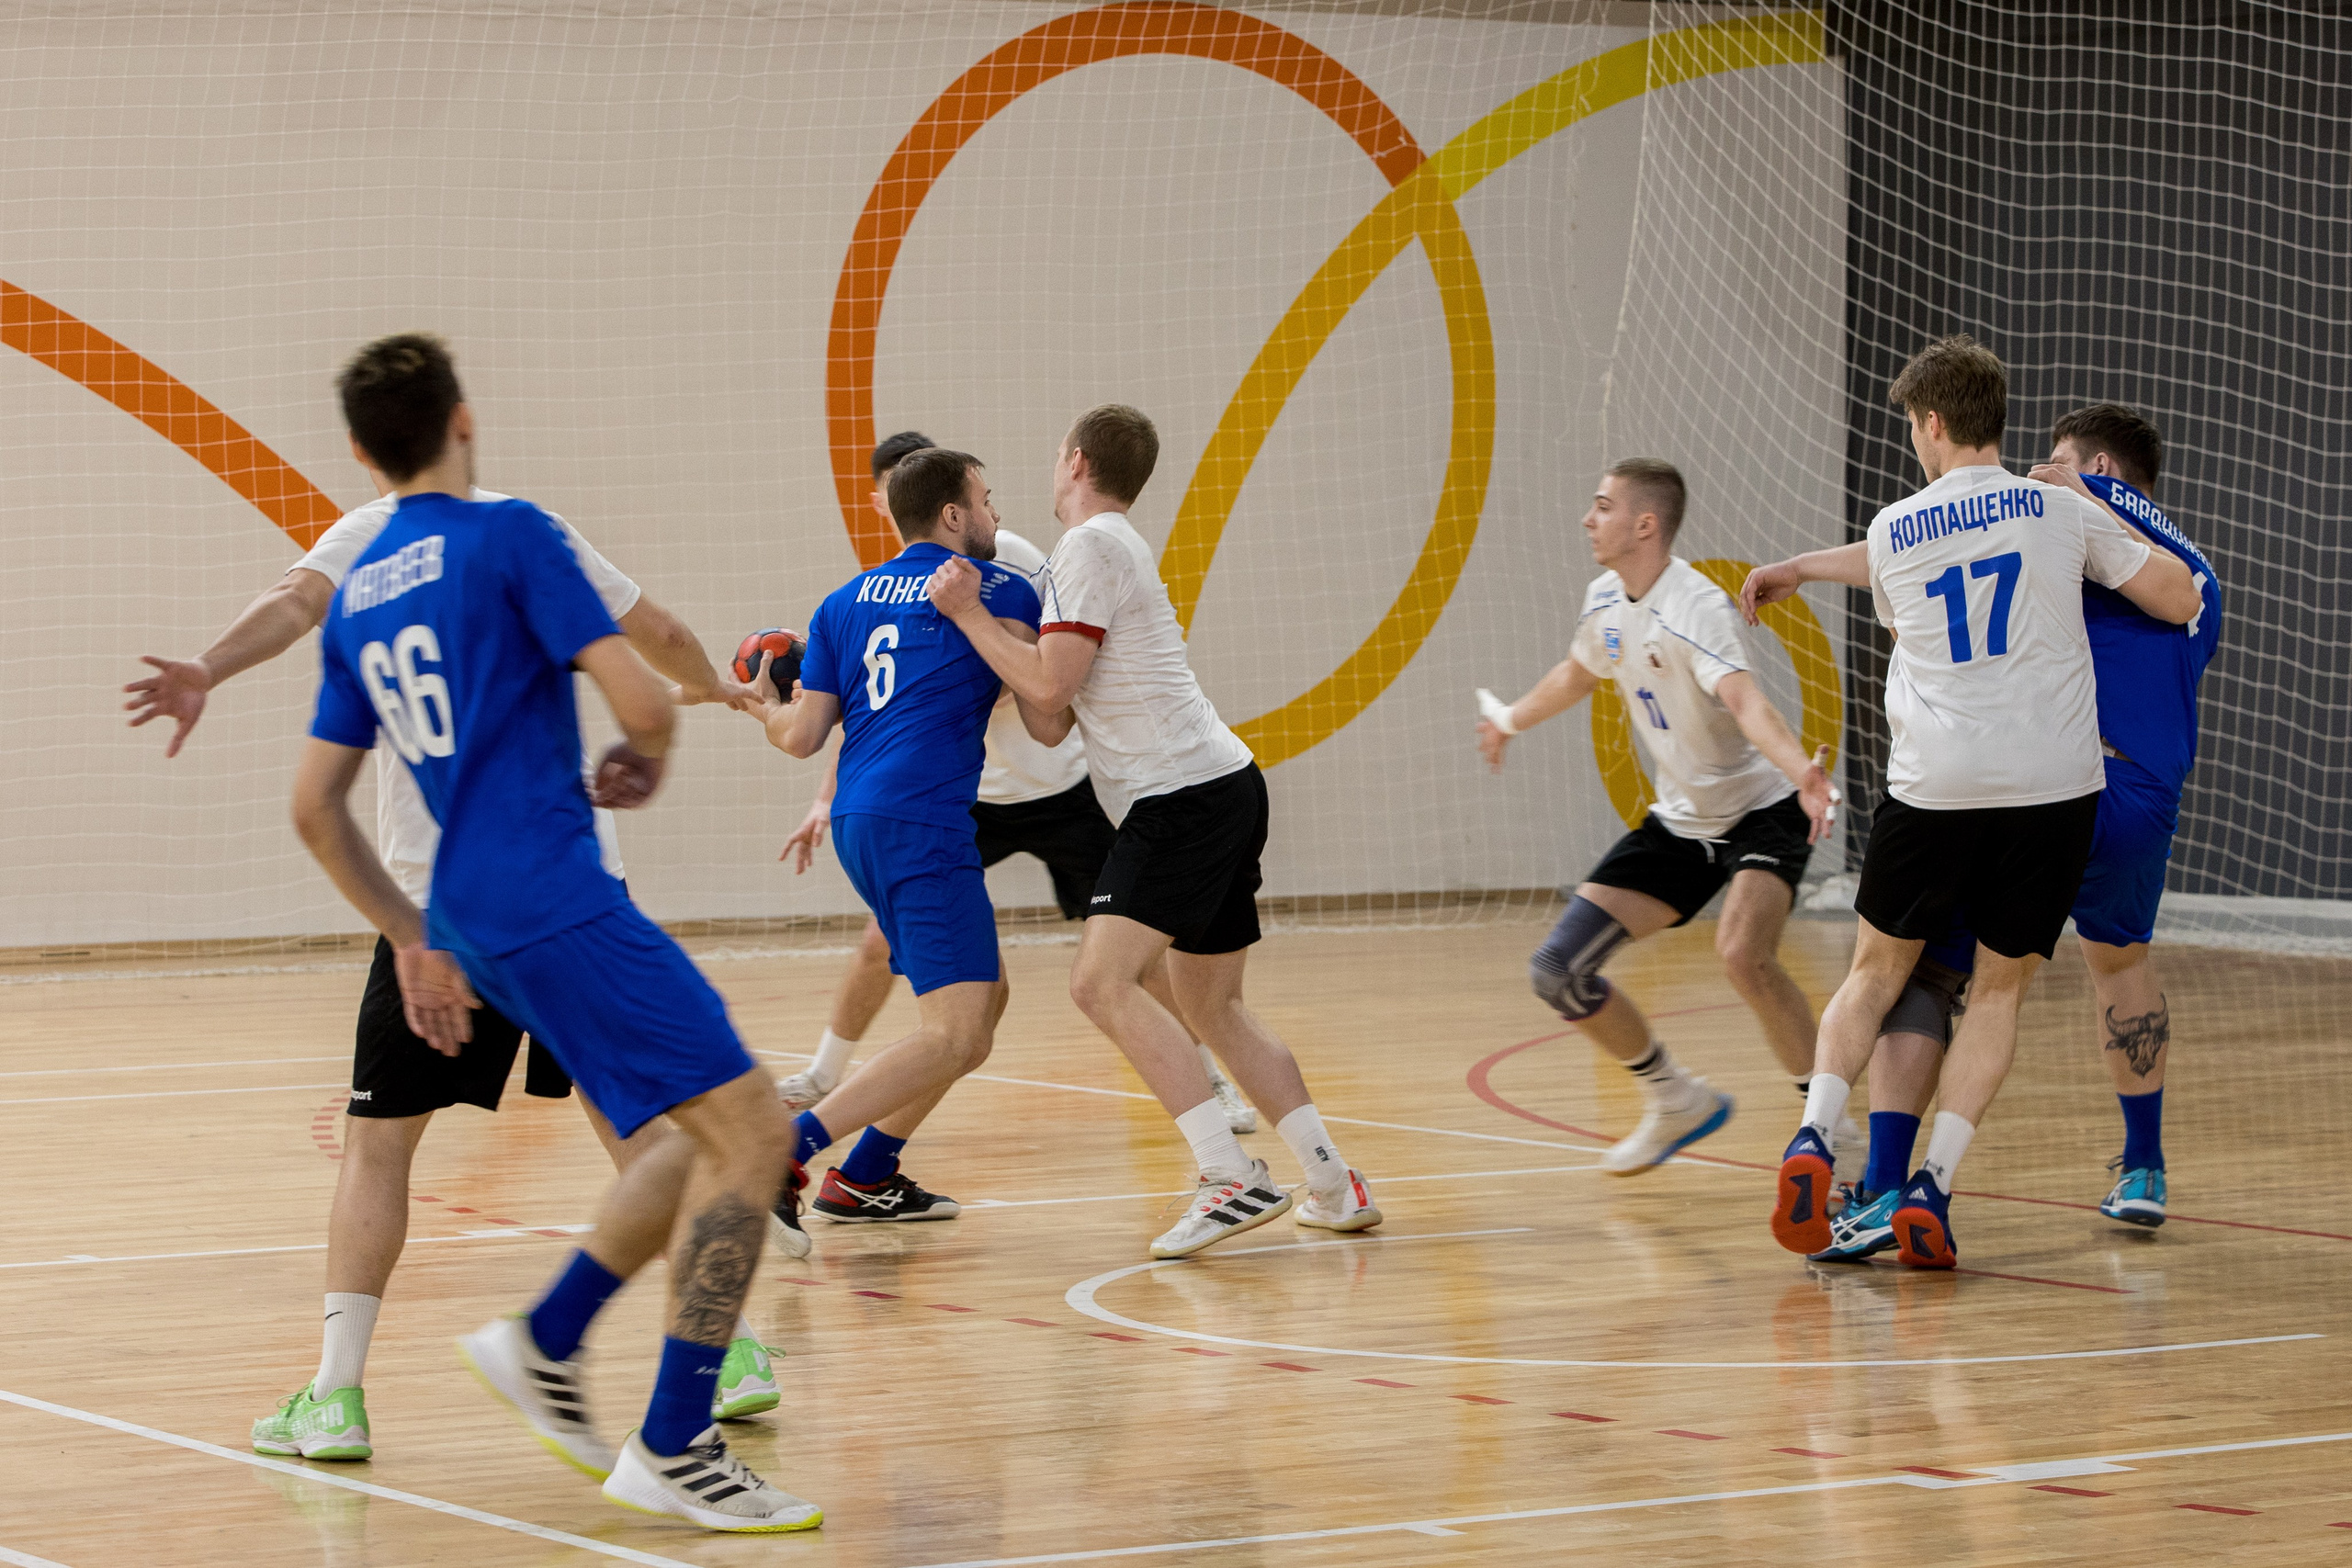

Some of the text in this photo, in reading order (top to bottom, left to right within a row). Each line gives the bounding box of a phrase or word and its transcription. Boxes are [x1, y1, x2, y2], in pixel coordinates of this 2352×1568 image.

[1890, 488, 2043, 553] КОЛПАЩЕНКО
[1925, 551, 2022, 663] 17
[359, 625, 455, 764] 66
[864, 624, 899, 711] 6
